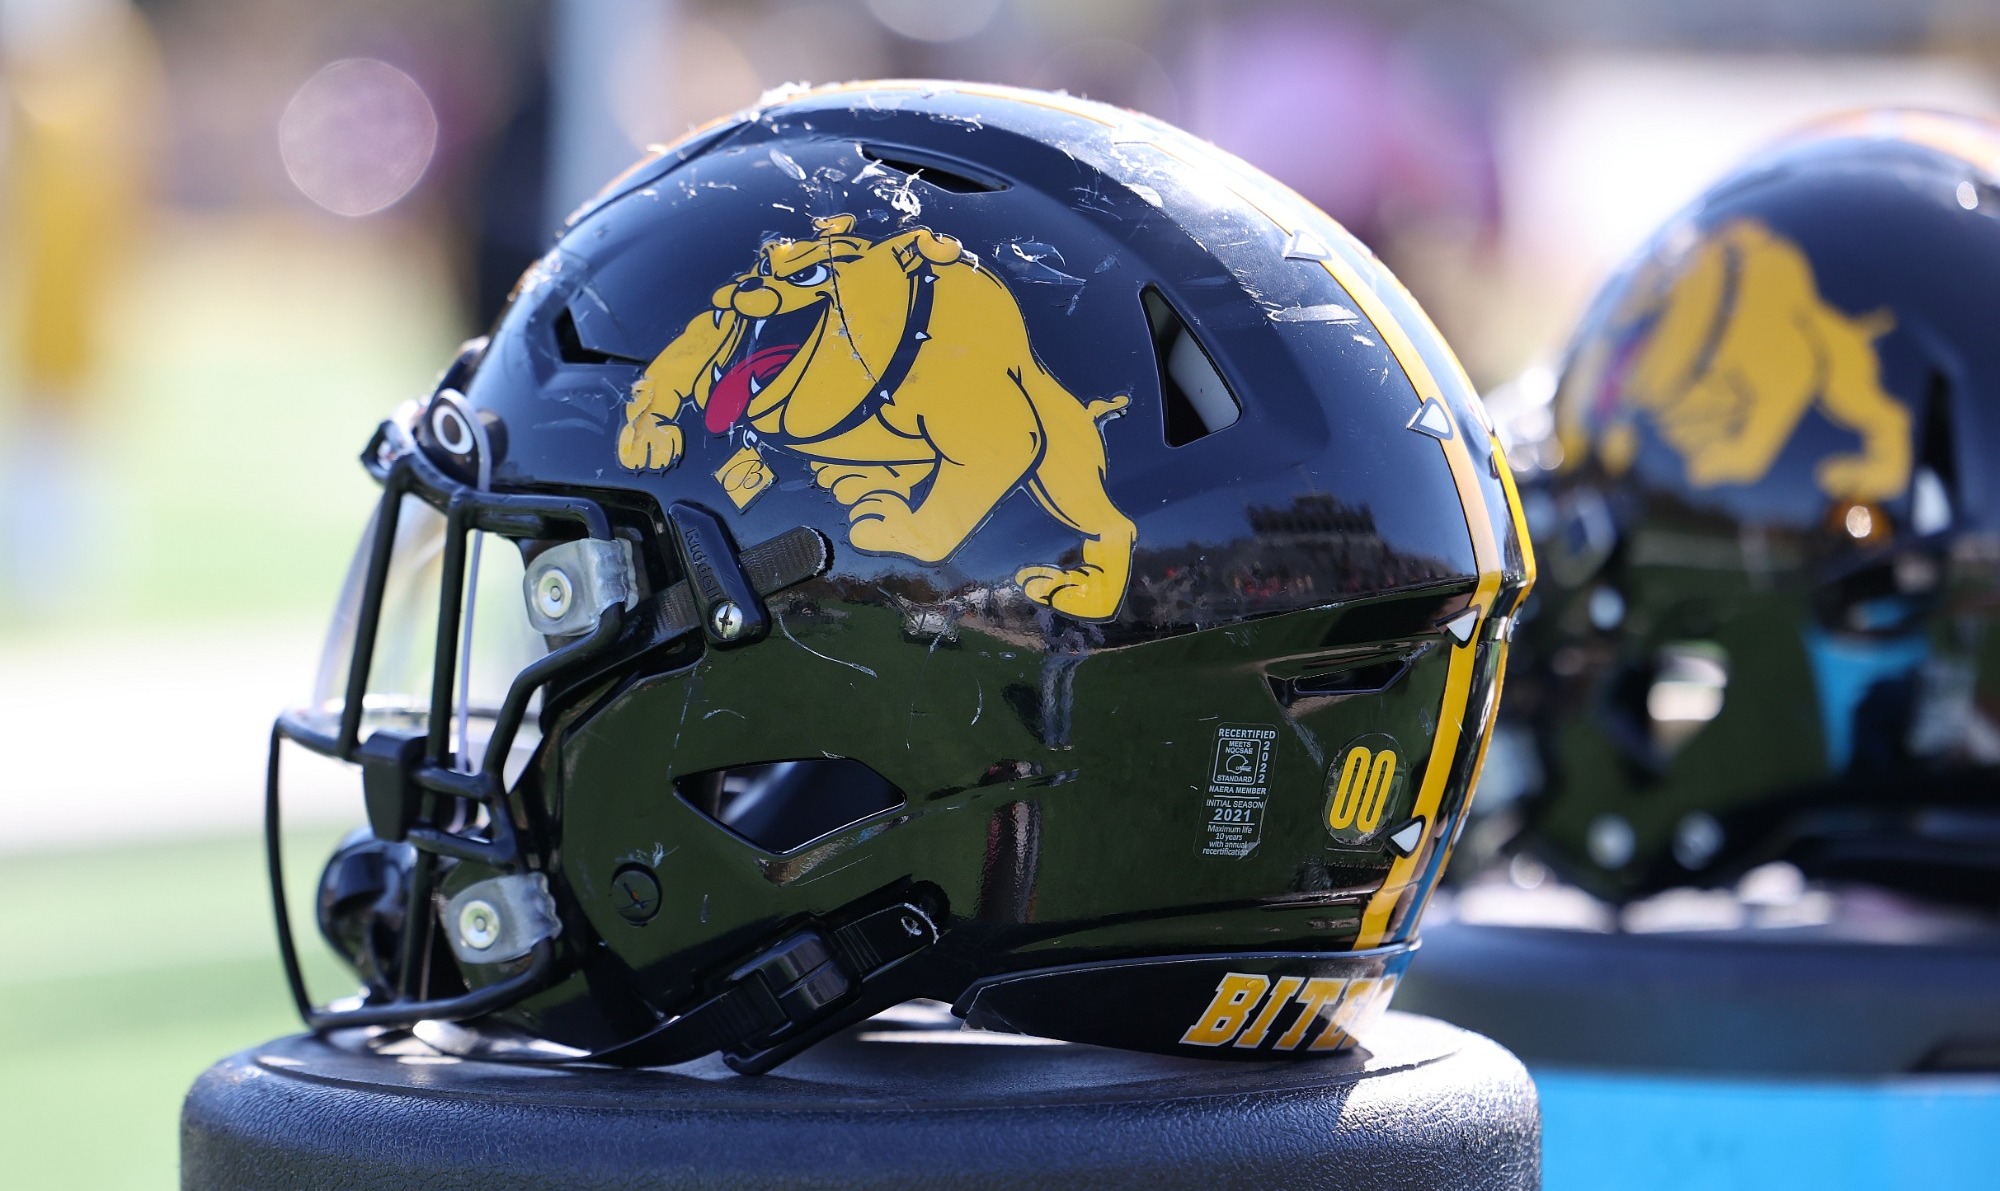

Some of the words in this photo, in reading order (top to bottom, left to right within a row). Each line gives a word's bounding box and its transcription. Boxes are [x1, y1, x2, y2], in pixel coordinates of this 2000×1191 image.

[1218, 728, 1276, 739] RECERTIFIED
[1217, 774, 1253, 783] STANDARD
[1208, 785, 1234, 794] NAERA
[1235, 786, 1267, 795] MEMBER
[1329, 746, 1397, 833] 00
[1206, 799, 1231, 808] INITIAL
[1233, 800, 1265, 809] SEASON
[1213, 808, 1251, 822] 2021
[1207, 825, 1241, 833] Maximum
[1241, 825, 1253, 834] life
[1215, 832, 1225, 840] 10
[1225, 833, 1243, 842] years
[1209, 840, 1224, 848] with
[1224, 840, 1248, 849] annual
[1202, 847, 1249, 856] recertification
[1178, 972, 1398, 1050] BITE
